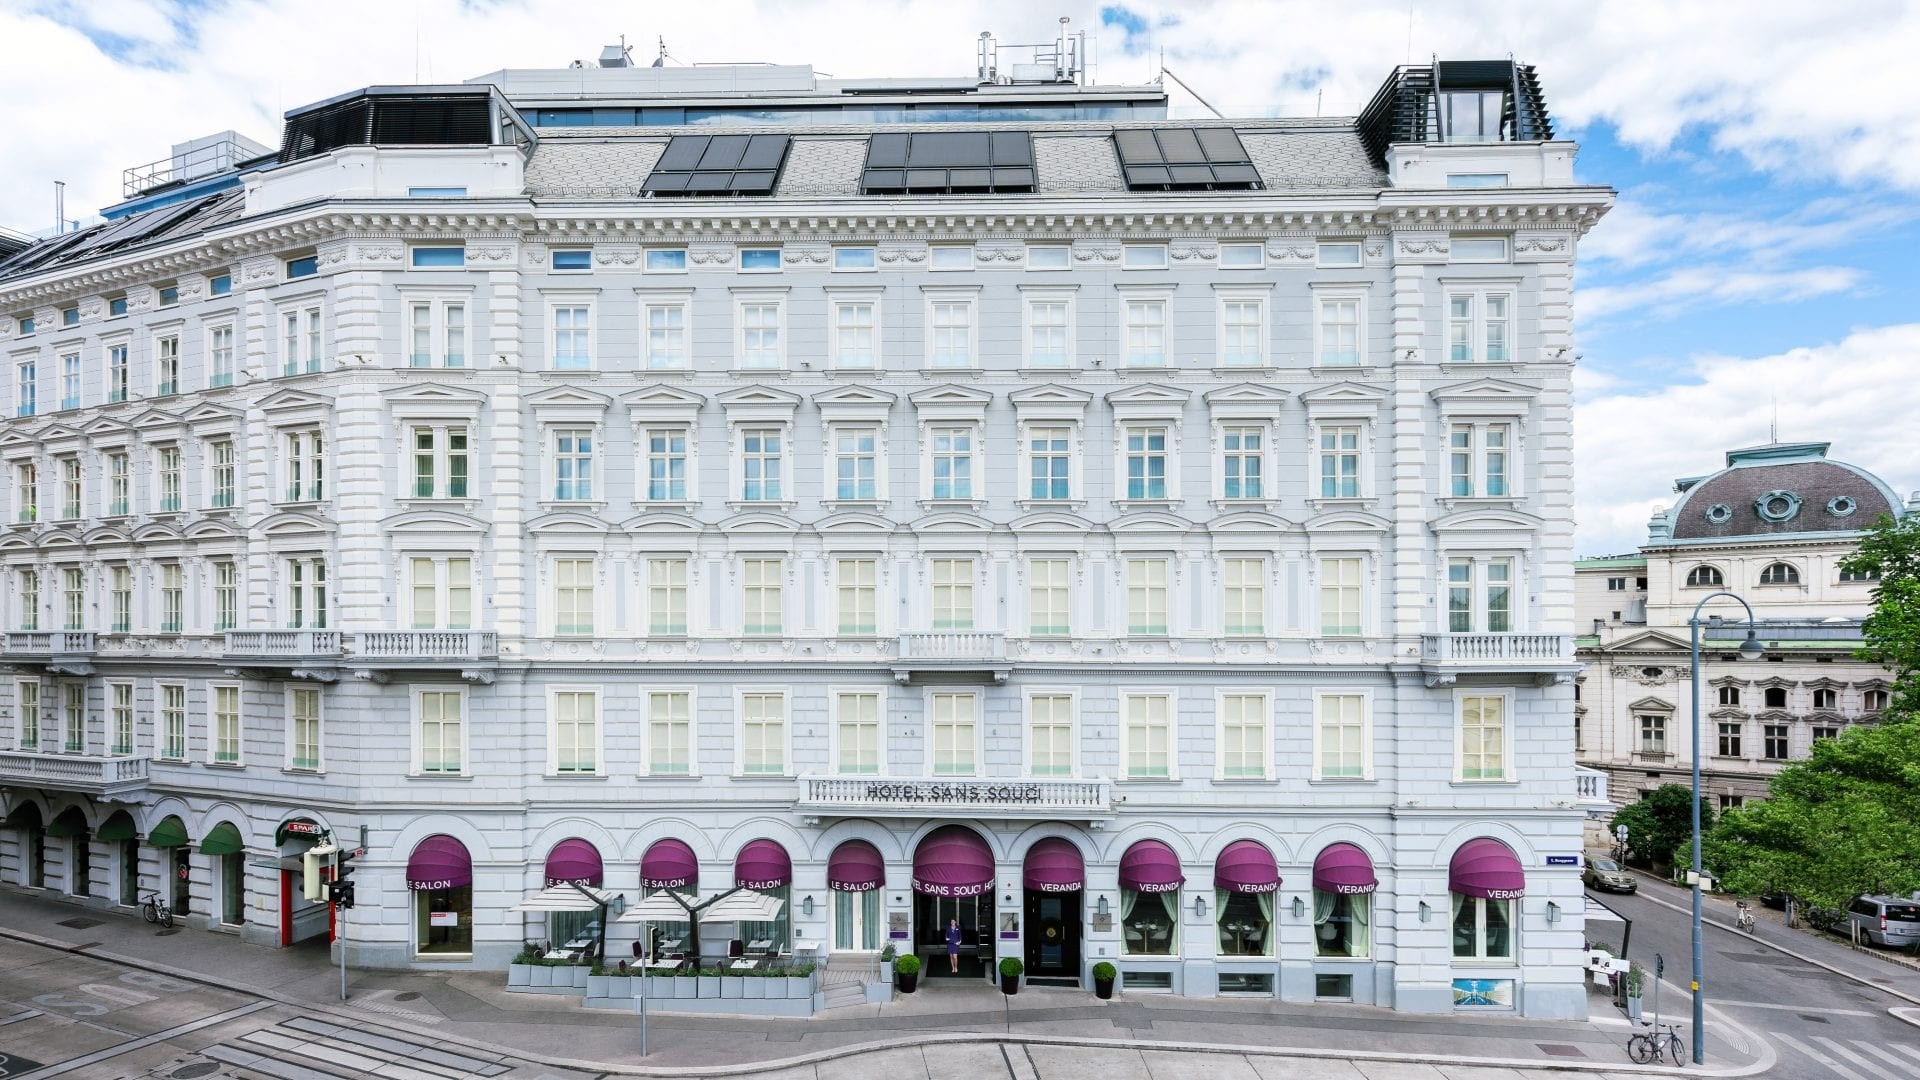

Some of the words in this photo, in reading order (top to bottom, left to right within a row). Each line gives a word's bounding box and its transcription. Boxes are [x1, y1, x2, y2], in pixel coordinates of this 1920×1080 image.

[867, 785, 920, 799] HOTEL
[931, 786, 979, 799] SANS
[988, 786, 1041, 800] SOUCI
[415, 880, 451, 890] SALON
[556, 878, 590, 886] SON
[641, 878, 649, 887] LE
[651, 878, 685, 888] SALON
[737, 879, 746, 887] LE
[748, 879, 781, 889] SALON
[831, 880, 841, 890] LE
[843, 881, 876, 891] SALON
[1040, 881, 1082, 892] VERANDA
[924, 883, 950, 896] SANS
[953, 884, 981, 896] SOUCI
[1487, 889, 1525, 899] VERAND
